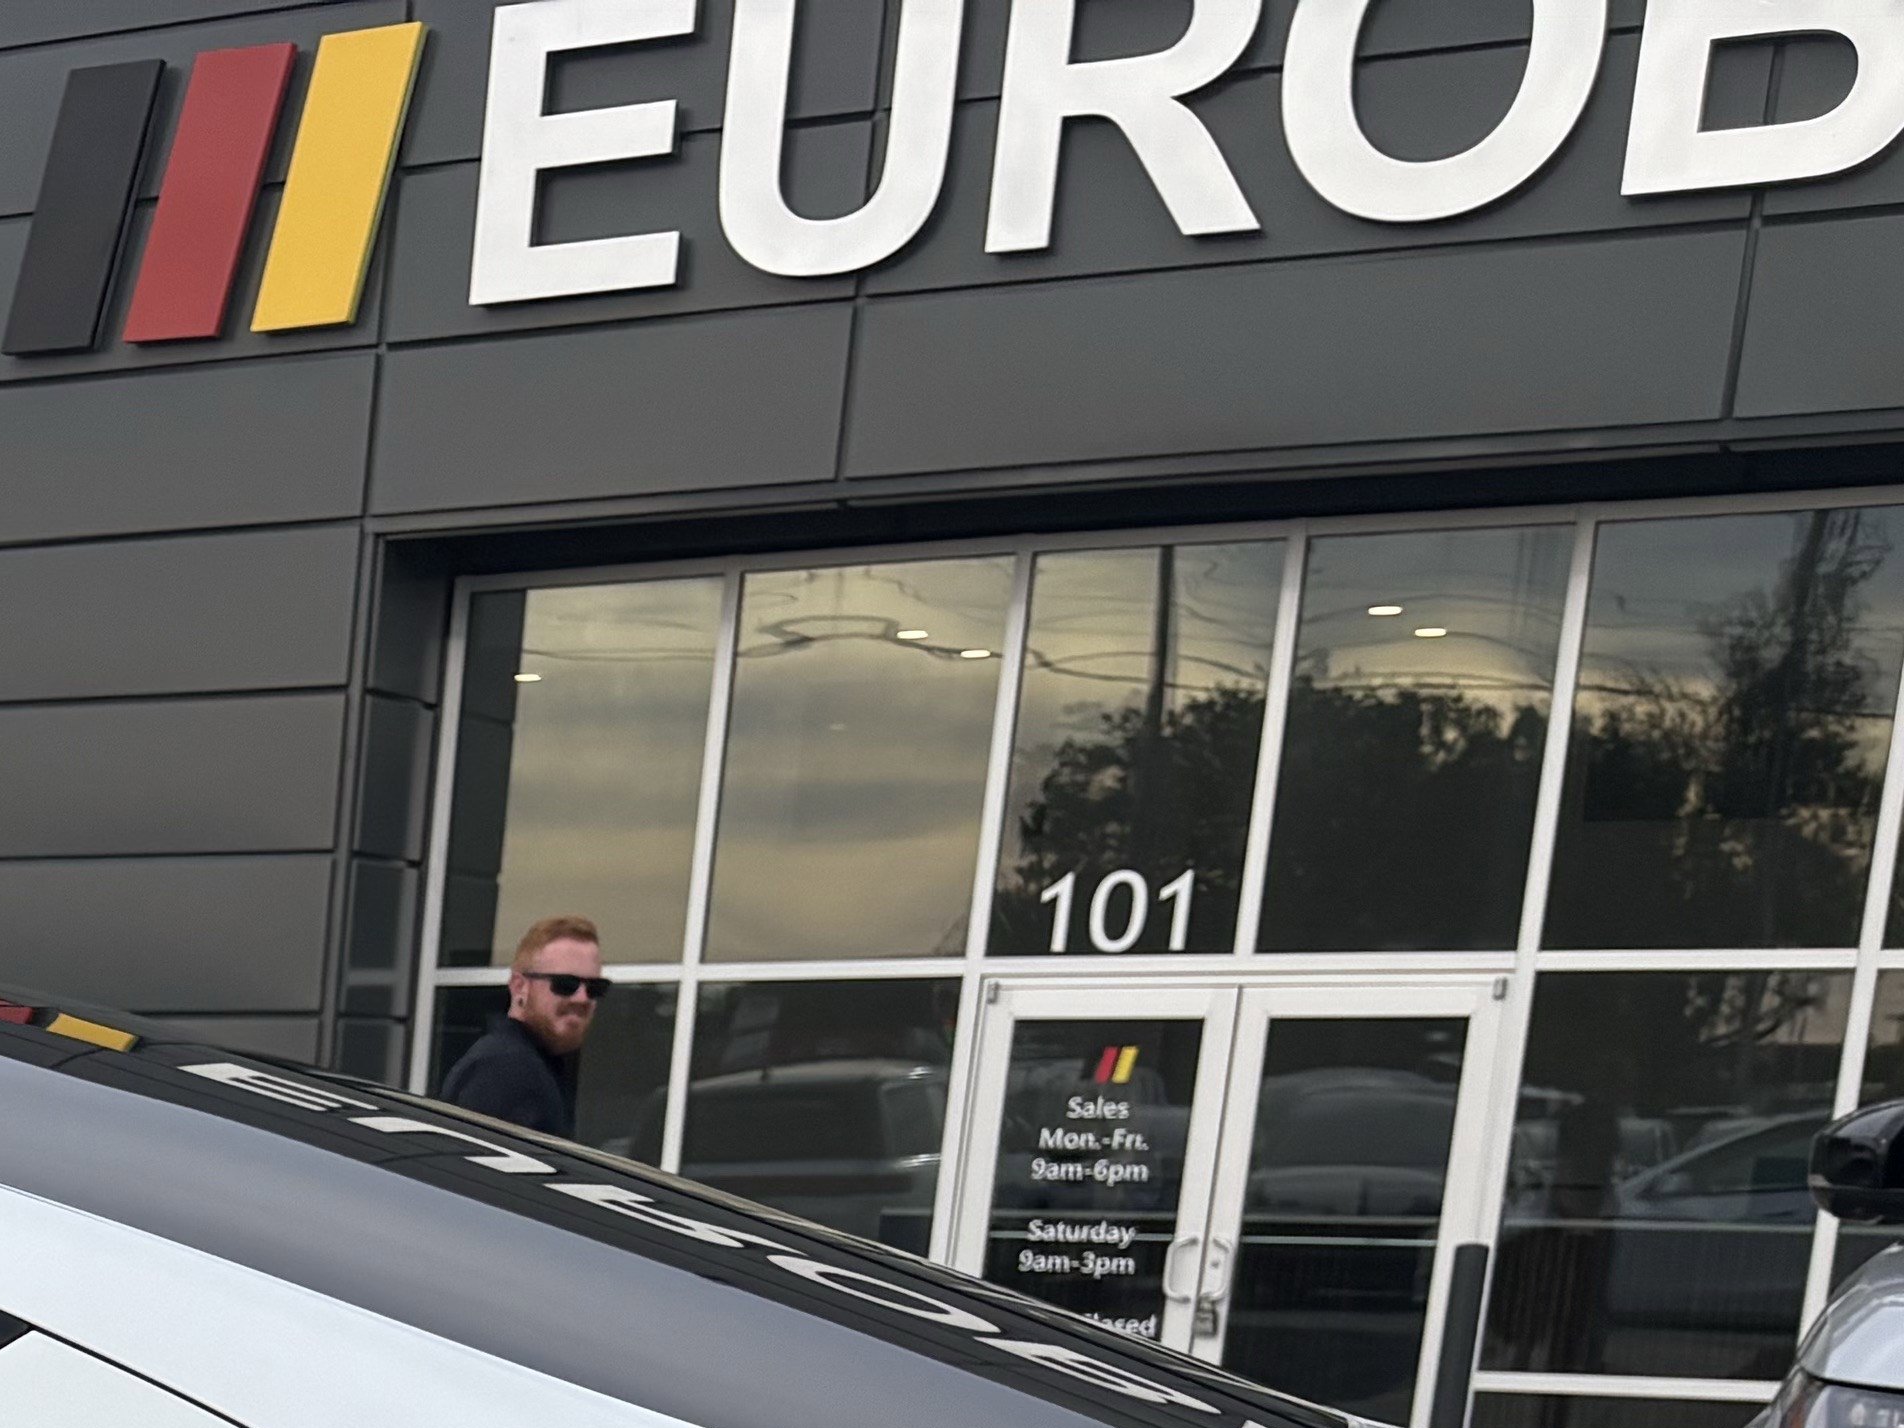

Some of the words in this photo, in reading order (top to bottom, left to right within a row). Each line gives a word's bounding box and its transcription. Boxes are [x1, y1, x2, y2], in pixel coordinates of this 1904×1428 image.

[1040, 868, 1195, 953] 101
[1066, 1096, 1130, 1119] Sales
[1039, 1127, 1149, 1151] Mon.-Fri.
[1030, 1157, 1149, 1187] 9am-6pm
[1026, 1218, 1137, 1249] Saturday
[1018, 1249, 1136, 1279] 9am-3pm
